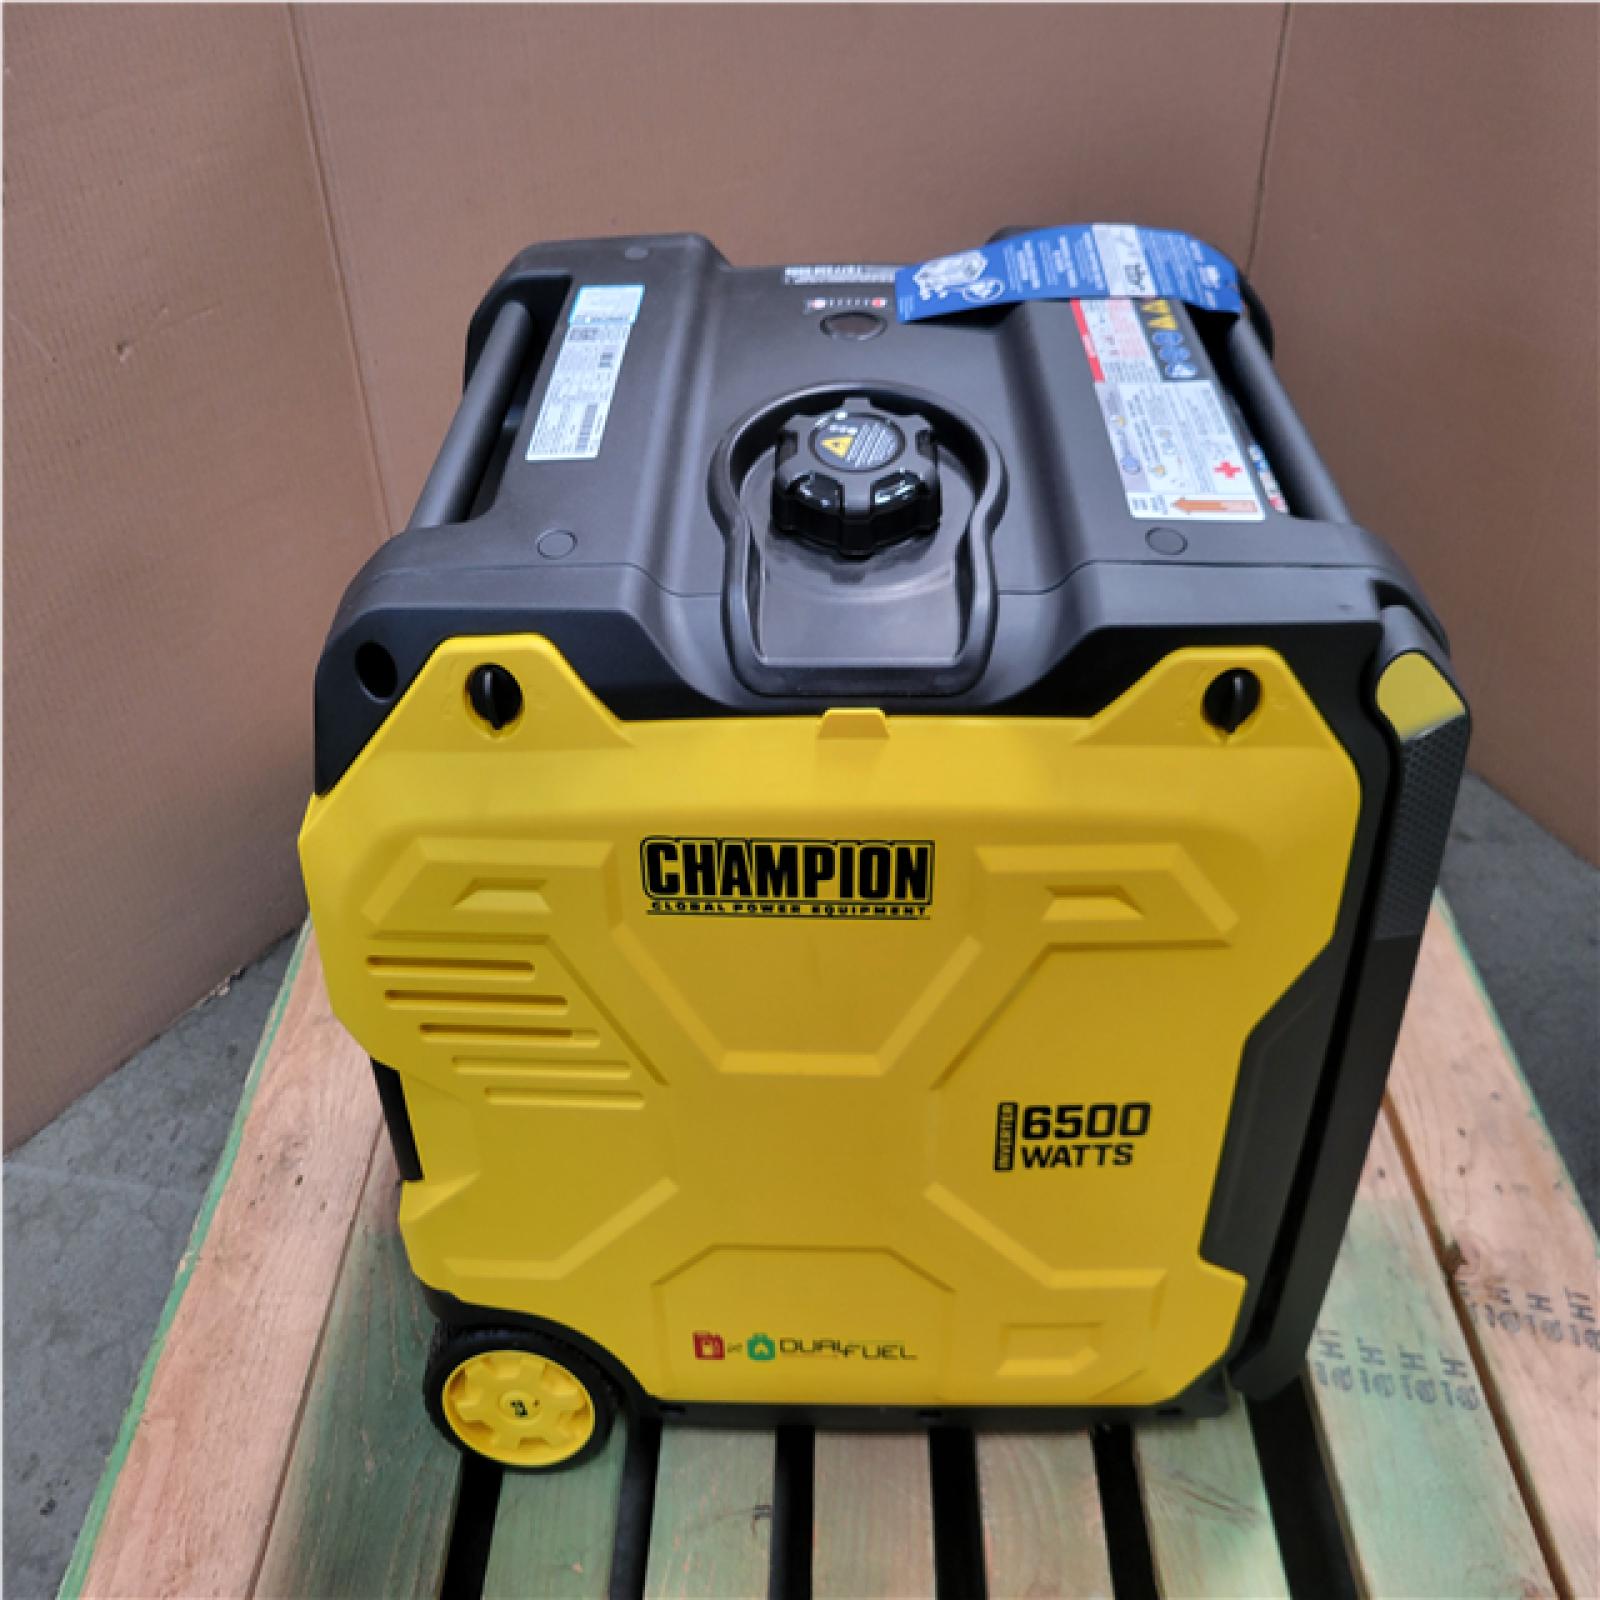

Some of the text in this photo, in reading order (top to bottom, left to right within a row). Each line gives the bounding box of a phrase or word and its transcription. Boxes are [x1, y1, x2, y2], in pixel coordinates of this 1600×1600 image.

[647, 842, 929, 900] CHAMPION
[1022, 1103, 1151, 1140] 6500
[1020, 1143, 1134, 1168] WATTS
